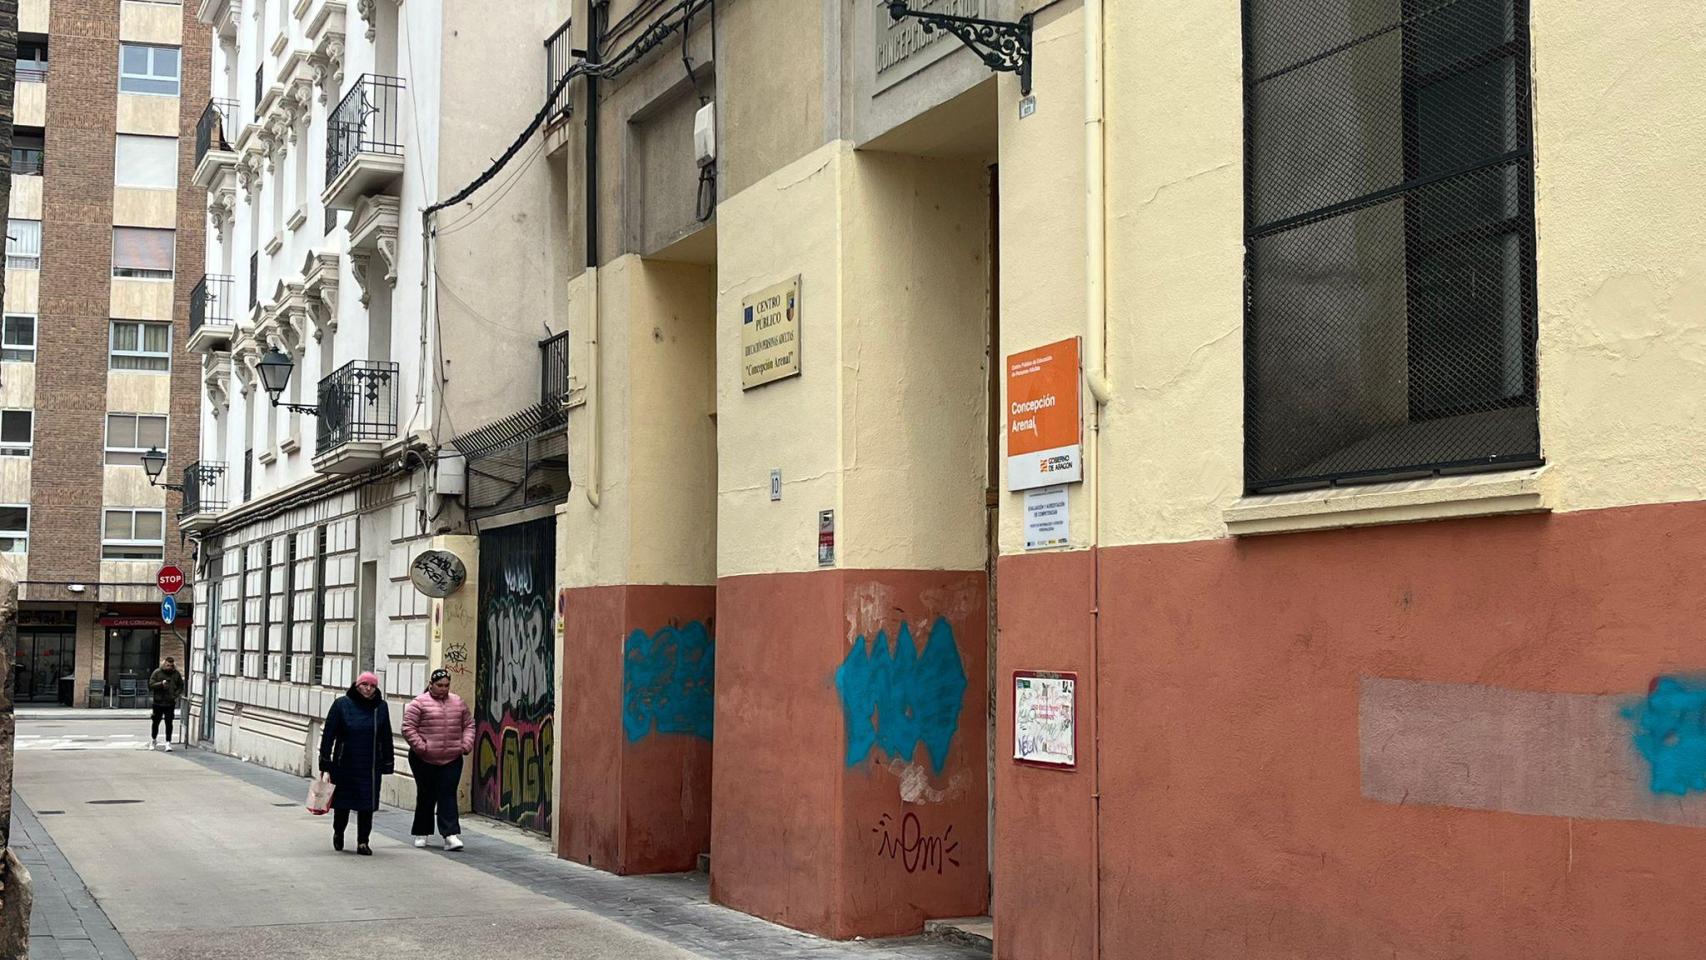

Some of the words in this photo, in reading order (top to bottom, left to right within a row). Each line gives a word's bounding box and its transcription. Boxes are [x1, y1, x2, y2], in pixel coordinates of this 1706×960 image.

[756, 295, 781, 314] CENTRO
[1011, 393, 1056, 415] Concepción
[1011, 415, 1035, 433] Arenal
[1048, 455, 1069, 465] GOBIERNO
[1048, 464, 1054, 472] DE
[159, 575, 181, 584] STOP
